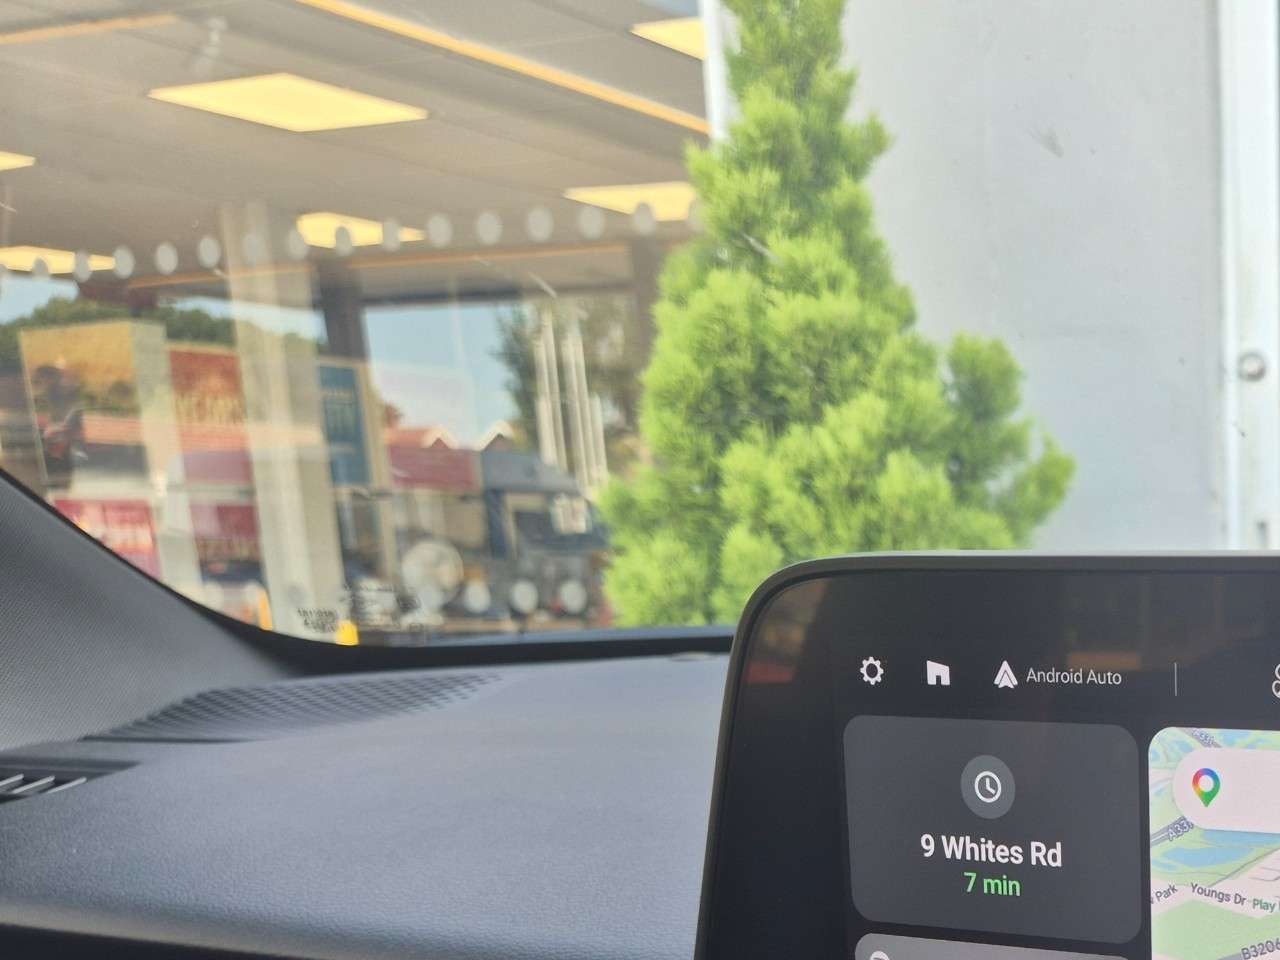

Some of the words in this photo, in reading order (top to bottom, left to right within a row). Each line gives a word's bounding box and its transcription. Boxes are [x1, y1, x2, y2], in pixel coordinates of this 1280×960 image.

[1025, 667, 1083, 686] Android
[1085, 669, 1122, 687] Auto
[920, 834, 936, 858] 9
[941, 835, 1024, 864] Whites
[1030, 839, 1063, 868] Rd
[963, 872, 978, 894] 7
[982, 873, 1021, 897] min
[1155, 884, 1178, 903] Park
[1190, 882, 1231, 903] Youngs
[1234, 893, 1247, 906] Dr
[1252, 899, 1276, 914] Play
